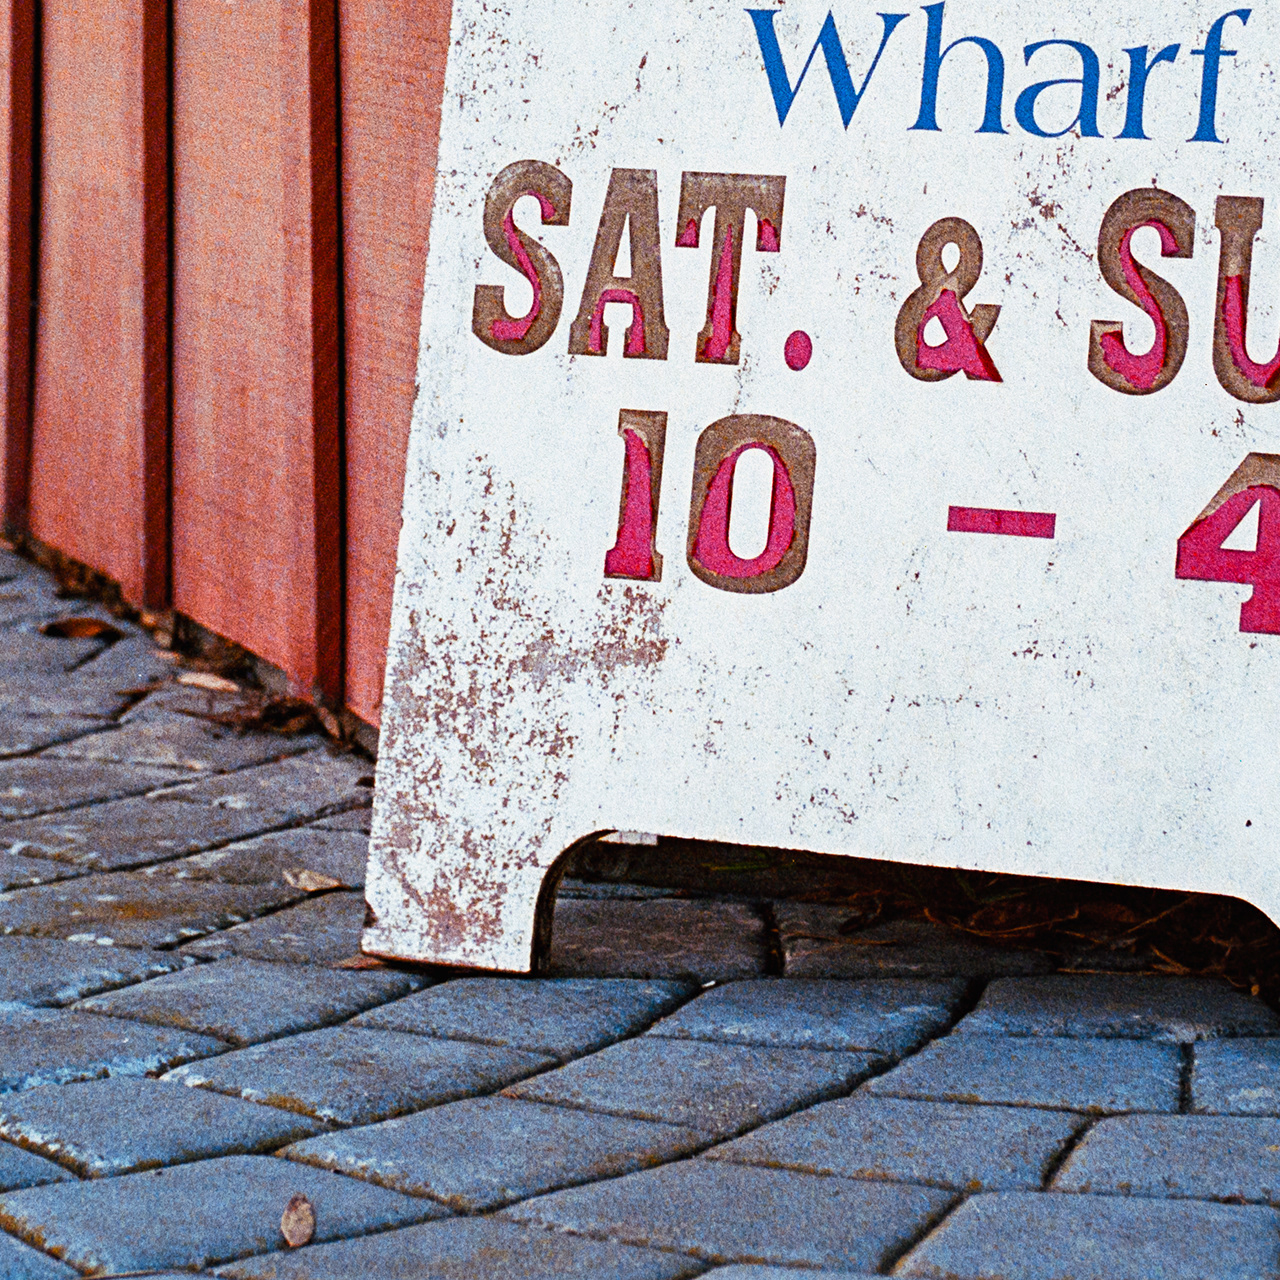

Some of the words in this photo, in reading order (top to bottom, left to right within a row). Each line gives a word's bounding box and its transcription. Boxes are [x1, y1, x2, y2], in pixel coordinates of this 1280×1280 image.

[745, 1, 1252, 144] Wharf
[471, 158, 813, 372] SAT.
[894, 216, 1004, 384] &
[602, 407, 817, 596] 10
